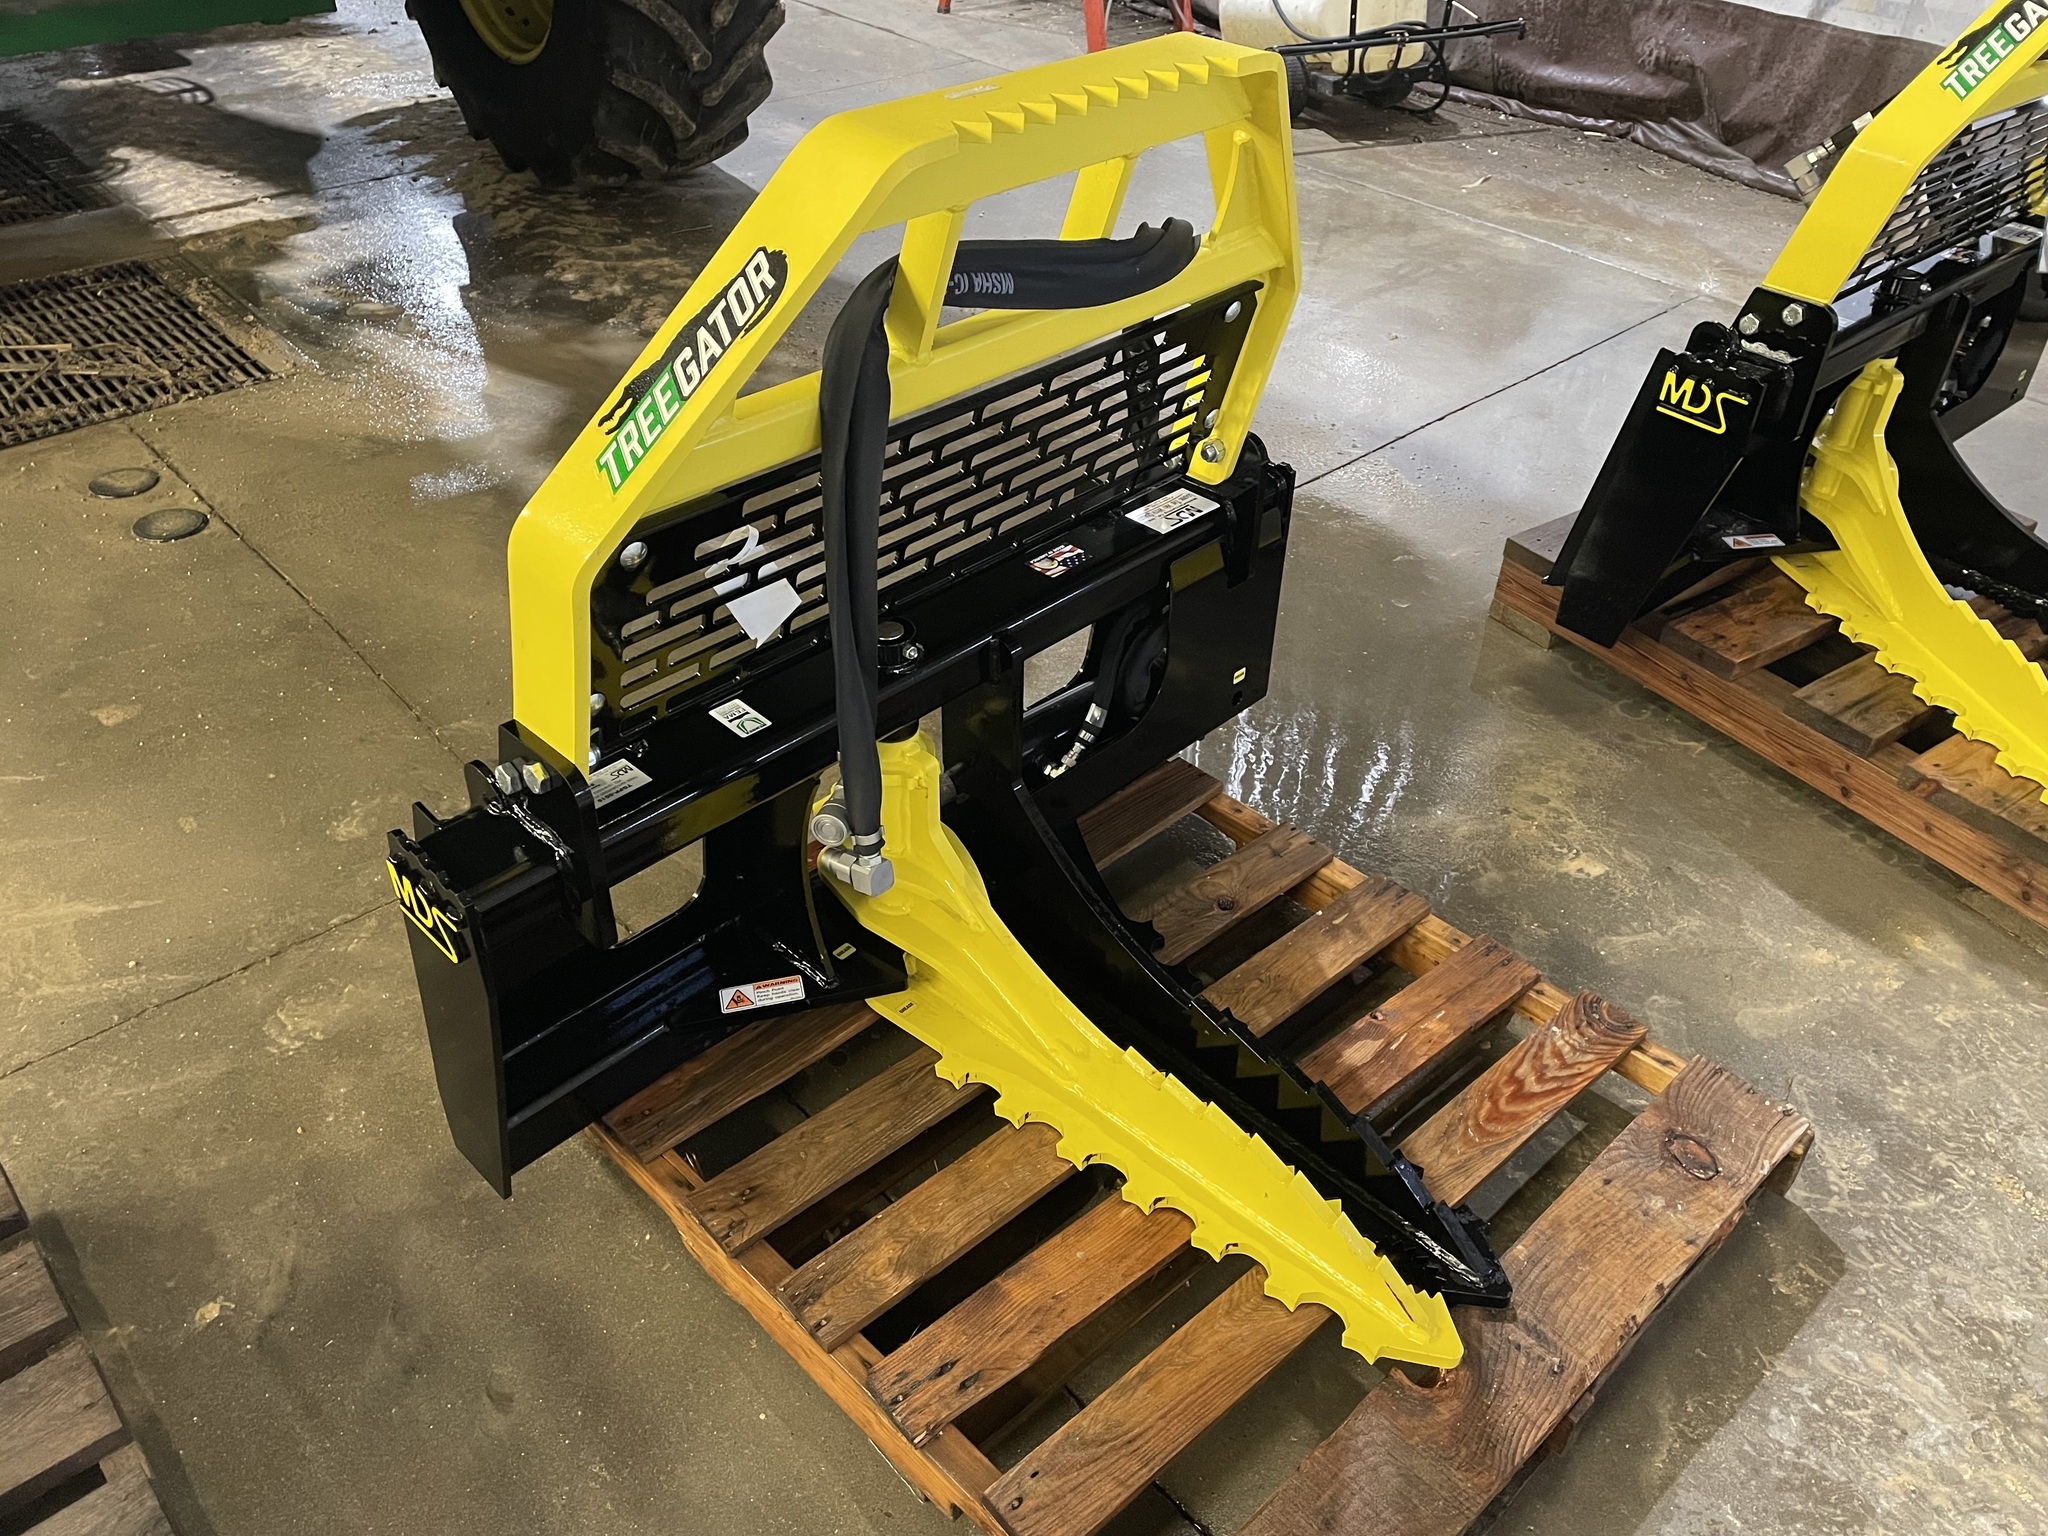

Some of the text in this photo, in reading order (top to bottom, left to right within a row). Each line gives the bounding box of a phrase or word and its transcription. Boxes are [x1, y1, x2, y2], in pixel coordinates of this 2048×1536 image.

[972, 272, 1015, 295] MSHA
[1656, 371, 1749, 434] MDS
[762, 978, 798, 988] WARNING
